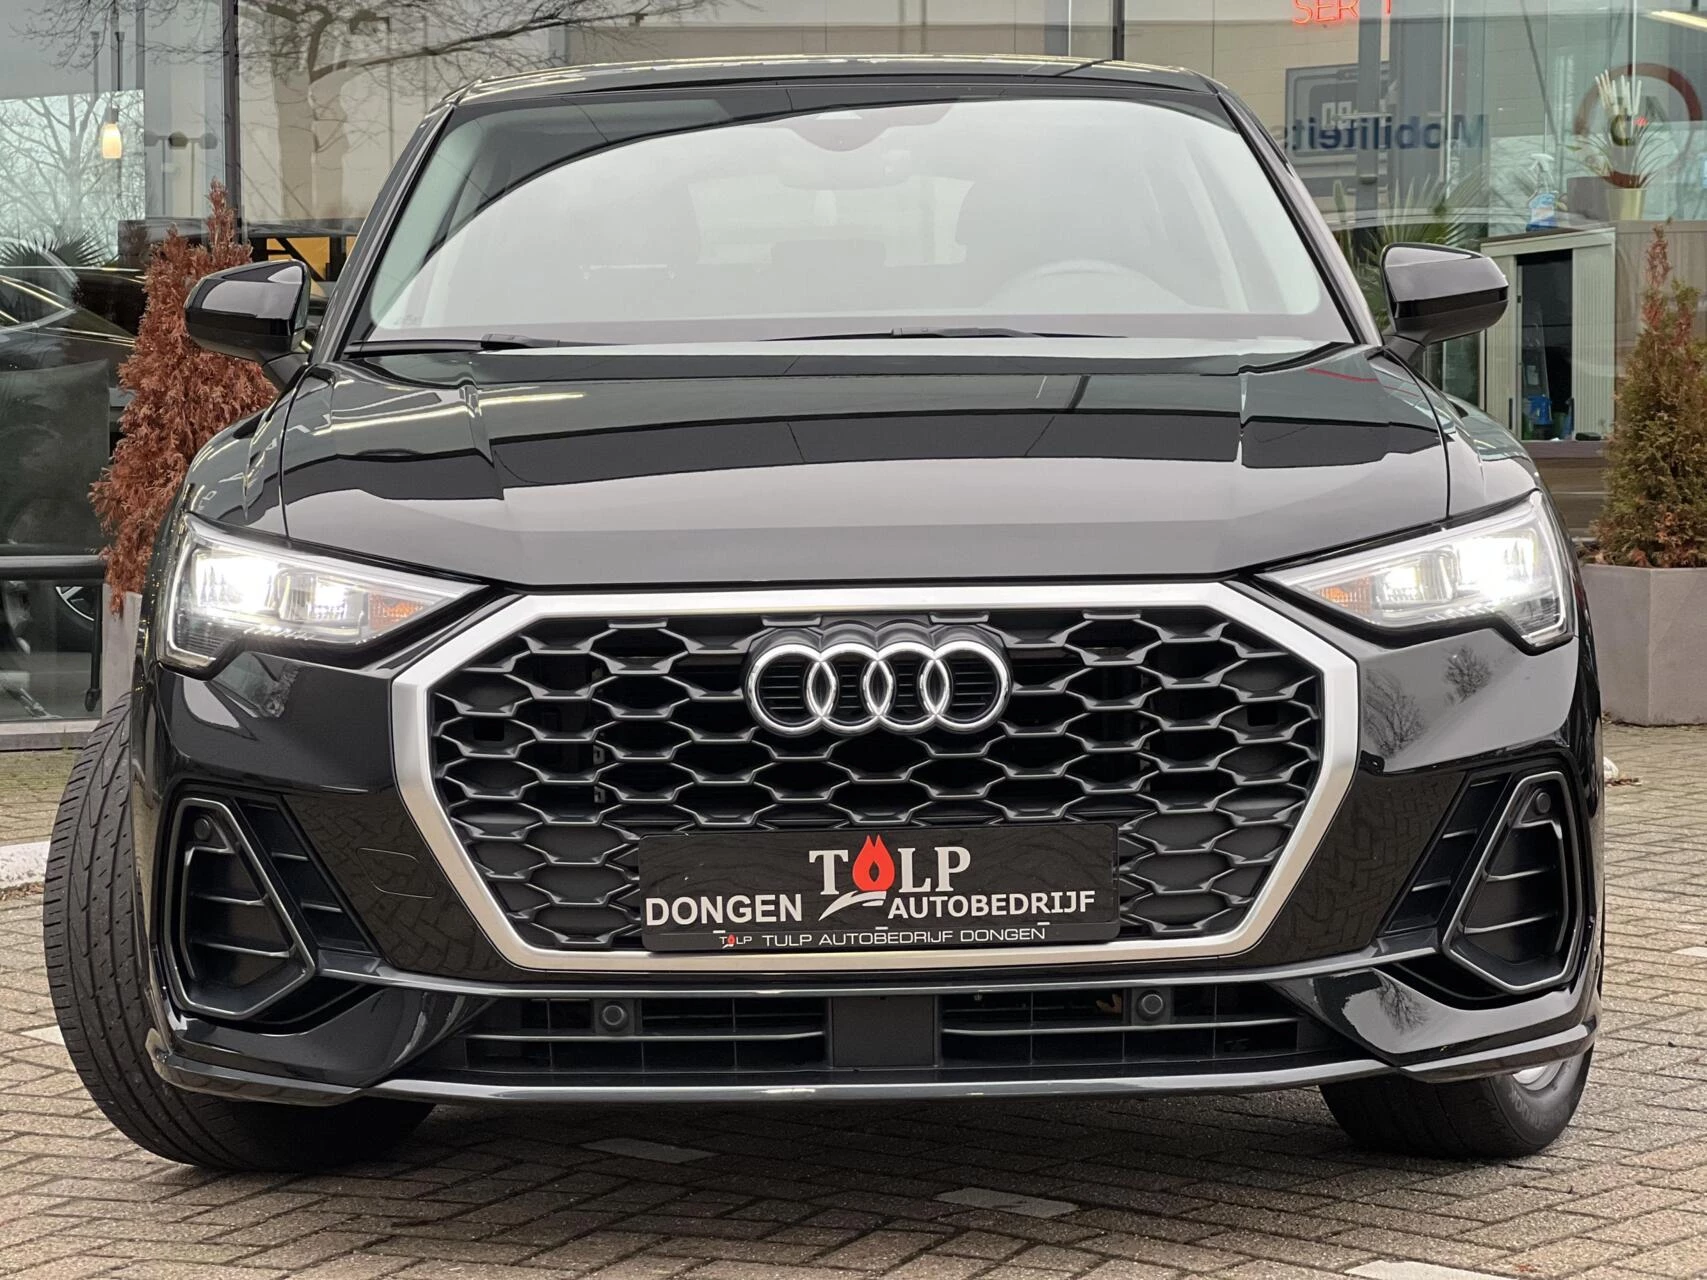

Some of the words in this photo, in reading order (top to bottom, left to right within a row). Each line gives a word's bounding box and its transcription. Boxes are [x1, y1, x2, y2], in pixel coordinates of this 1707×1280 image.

[645, 894, 802, 926] DONGEN
[887, 890, 1096, 919] AUTOBEDRIJF
[762, 933, 812, 947] TULP
[818, 930, 953, 945] AUTOBEDRIJF
[960, 928, 1046, 942] DONGEN
